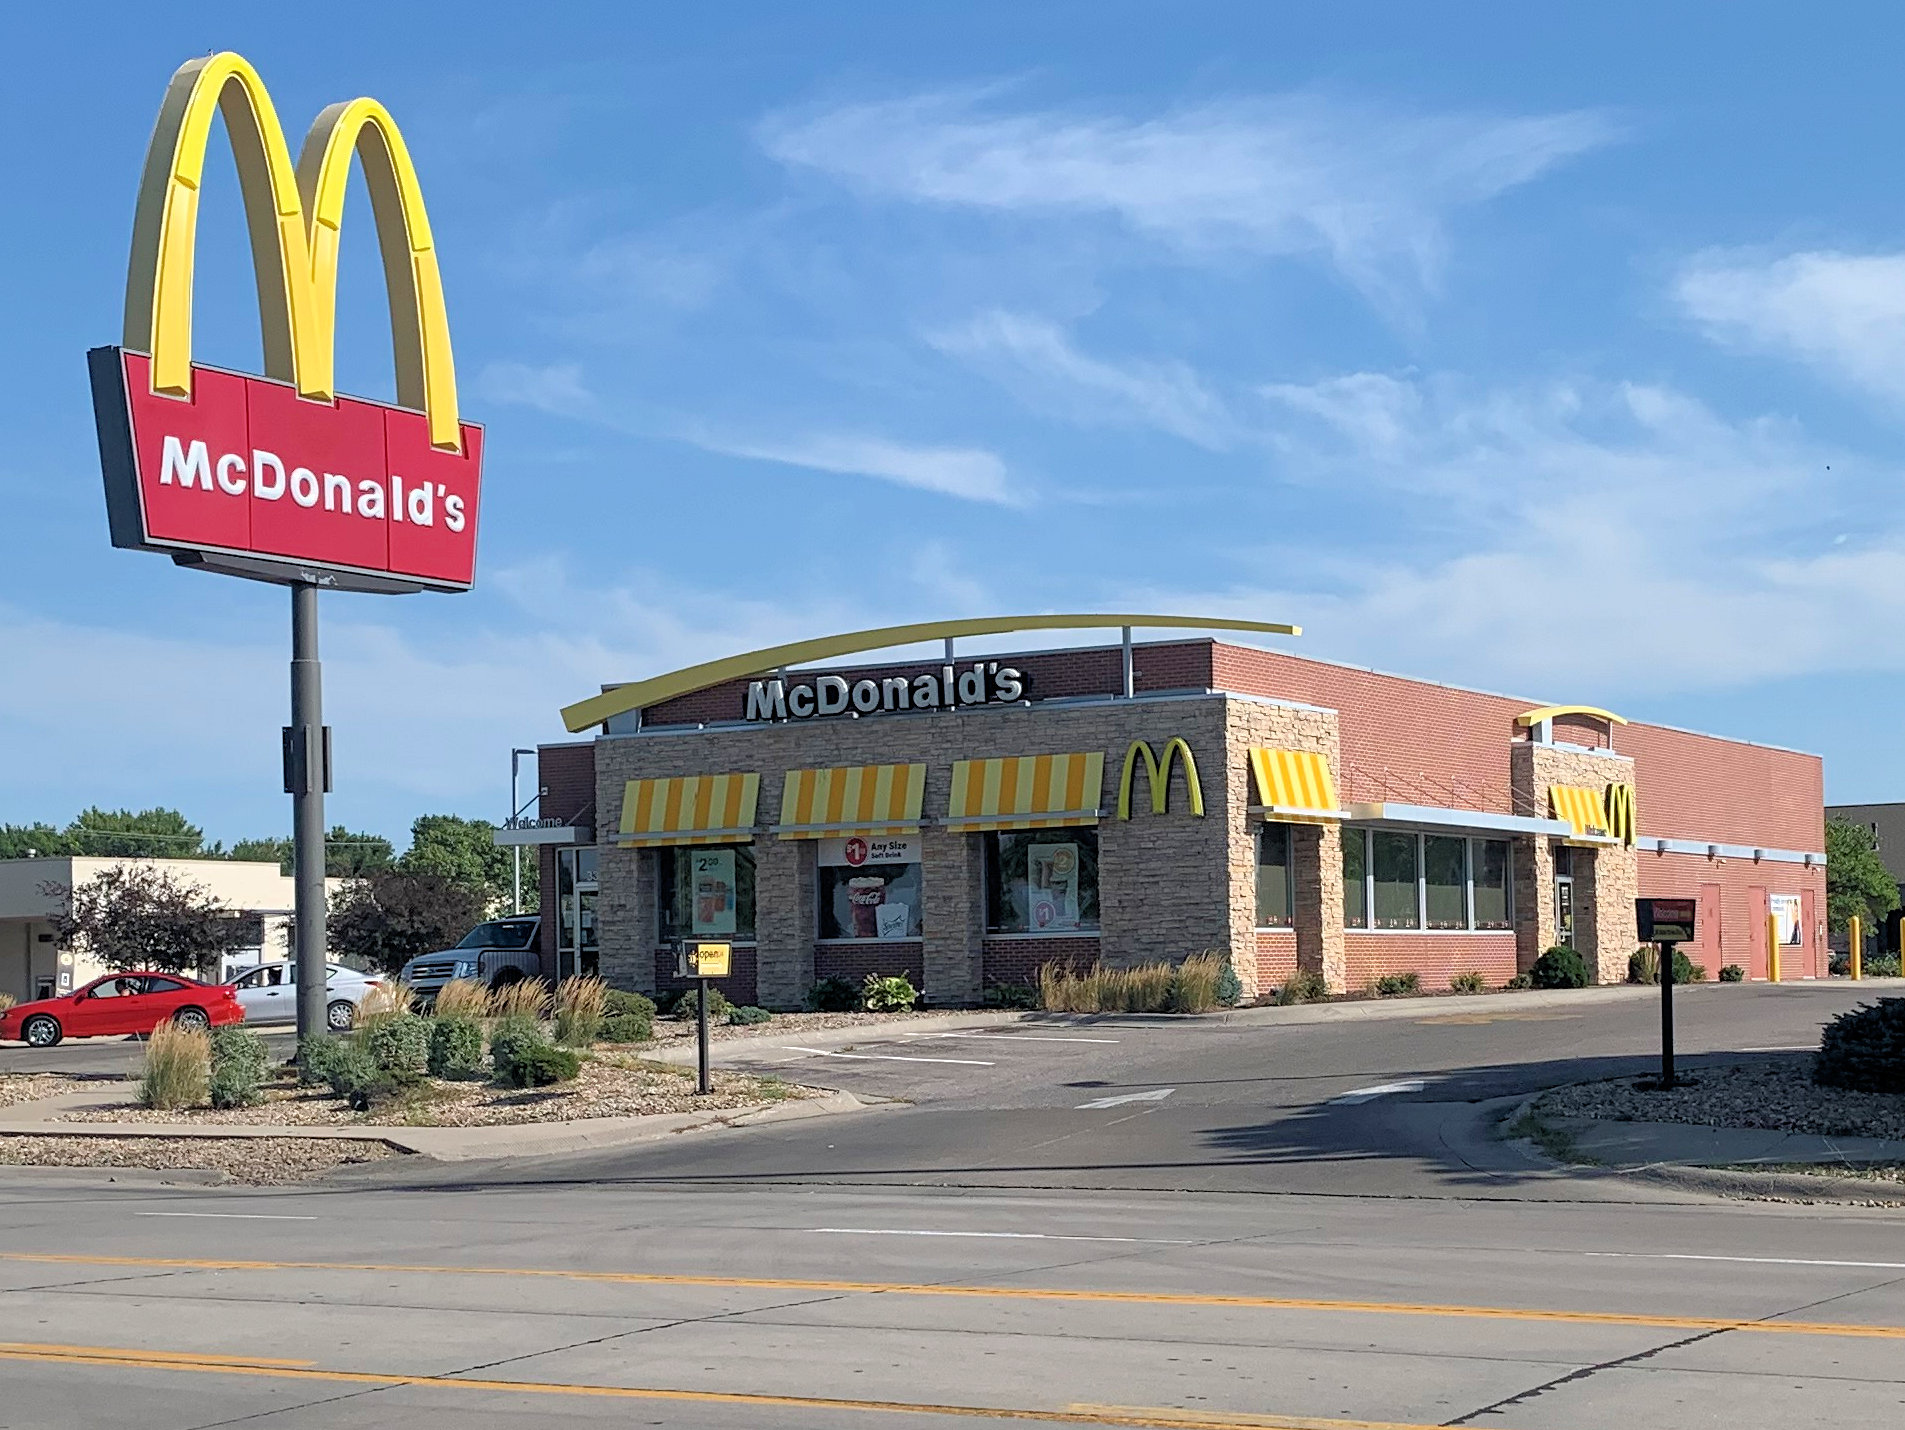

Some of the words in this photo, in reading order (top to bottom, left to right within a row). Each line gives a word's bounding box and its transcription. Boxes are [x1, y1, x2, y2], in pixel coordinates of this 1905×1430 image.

[158, 435, 466, 533] McDonald's
[746, 661, 1023, 721] McDonald's
[505, 816, 563, 831] Welcome
[871, 842, 887, 853] Any
[889, 840, 907, 850] Size
